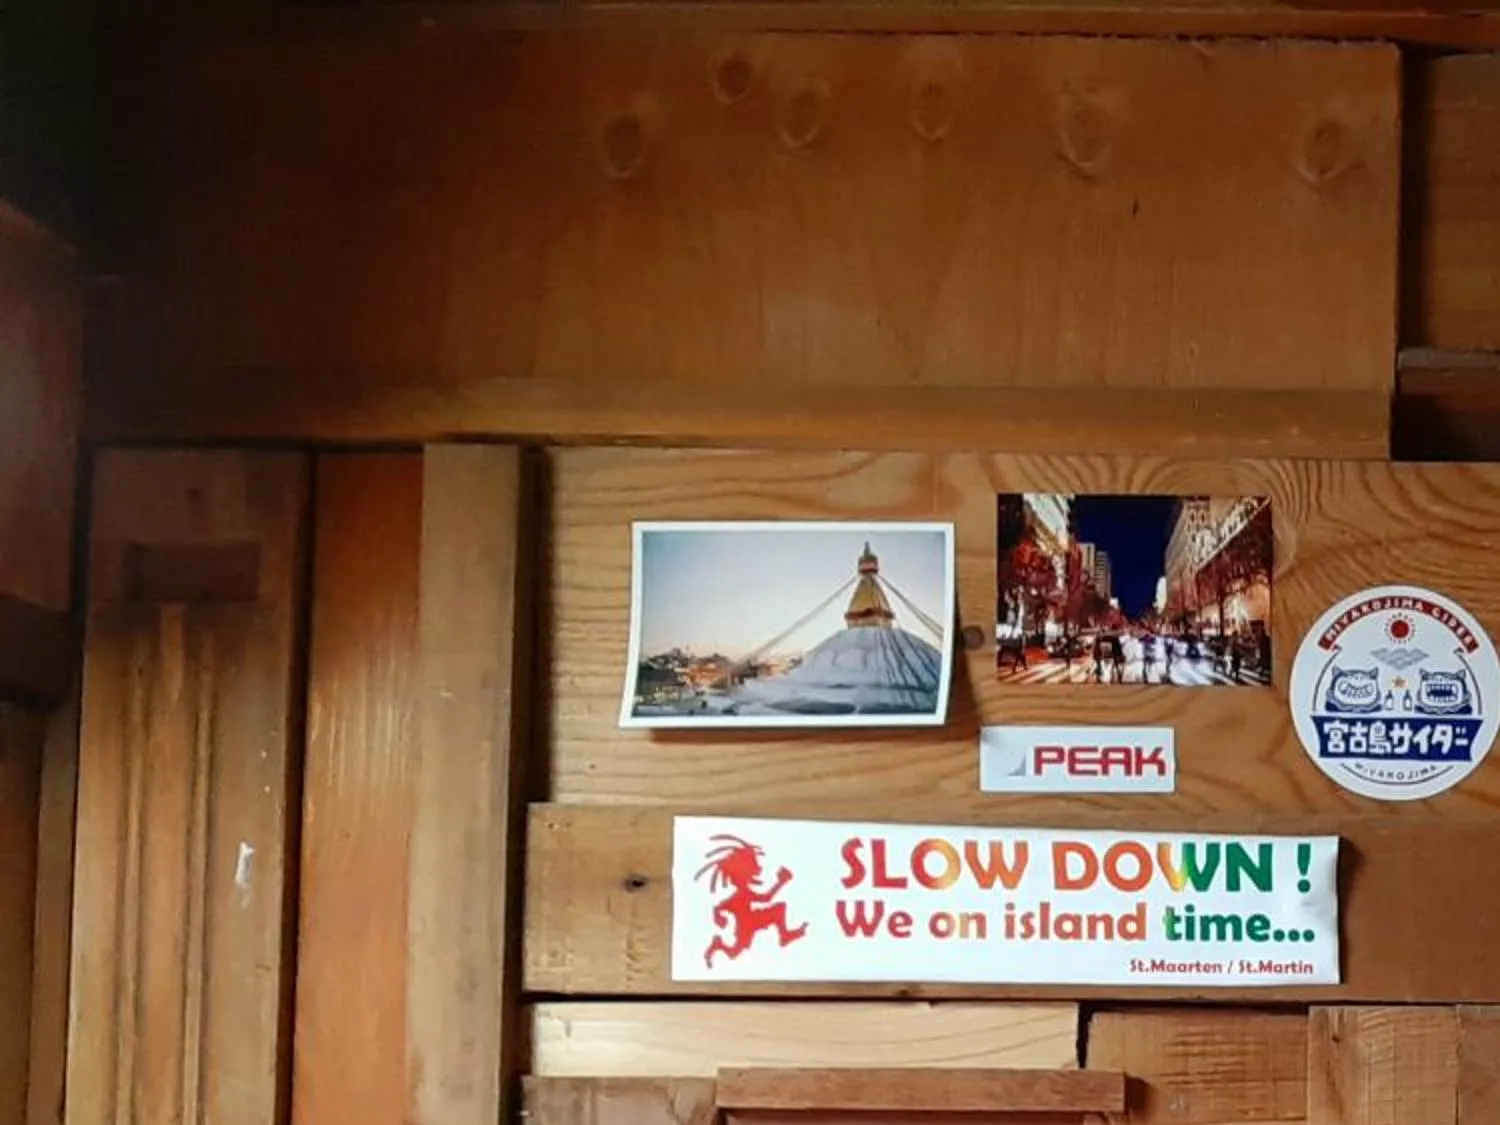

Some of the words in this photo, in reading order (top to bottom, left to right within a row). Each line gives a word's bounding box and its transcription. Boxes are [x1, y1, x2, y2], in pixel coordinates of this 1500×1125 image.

[1324, 598, 1424, 641] MIYAKOJIMA
[1431, 605, 1475, 645] CIDER
[1323, 720, 1469, 755] 宮古島サイダー
[1033, 746, 1167, 777] PEAK
[1353, 760, 1438, 780] MIYAKOJIMA
[840, 837, 1029, 890] SLOW
[1051, 840, 1273, 893] DOWN
[835, 899, 914, 938] We
[928, 911, 988, 940] on
[1004, 901, 1148, 941] island
[1162, 903, 1316, 943] time...
